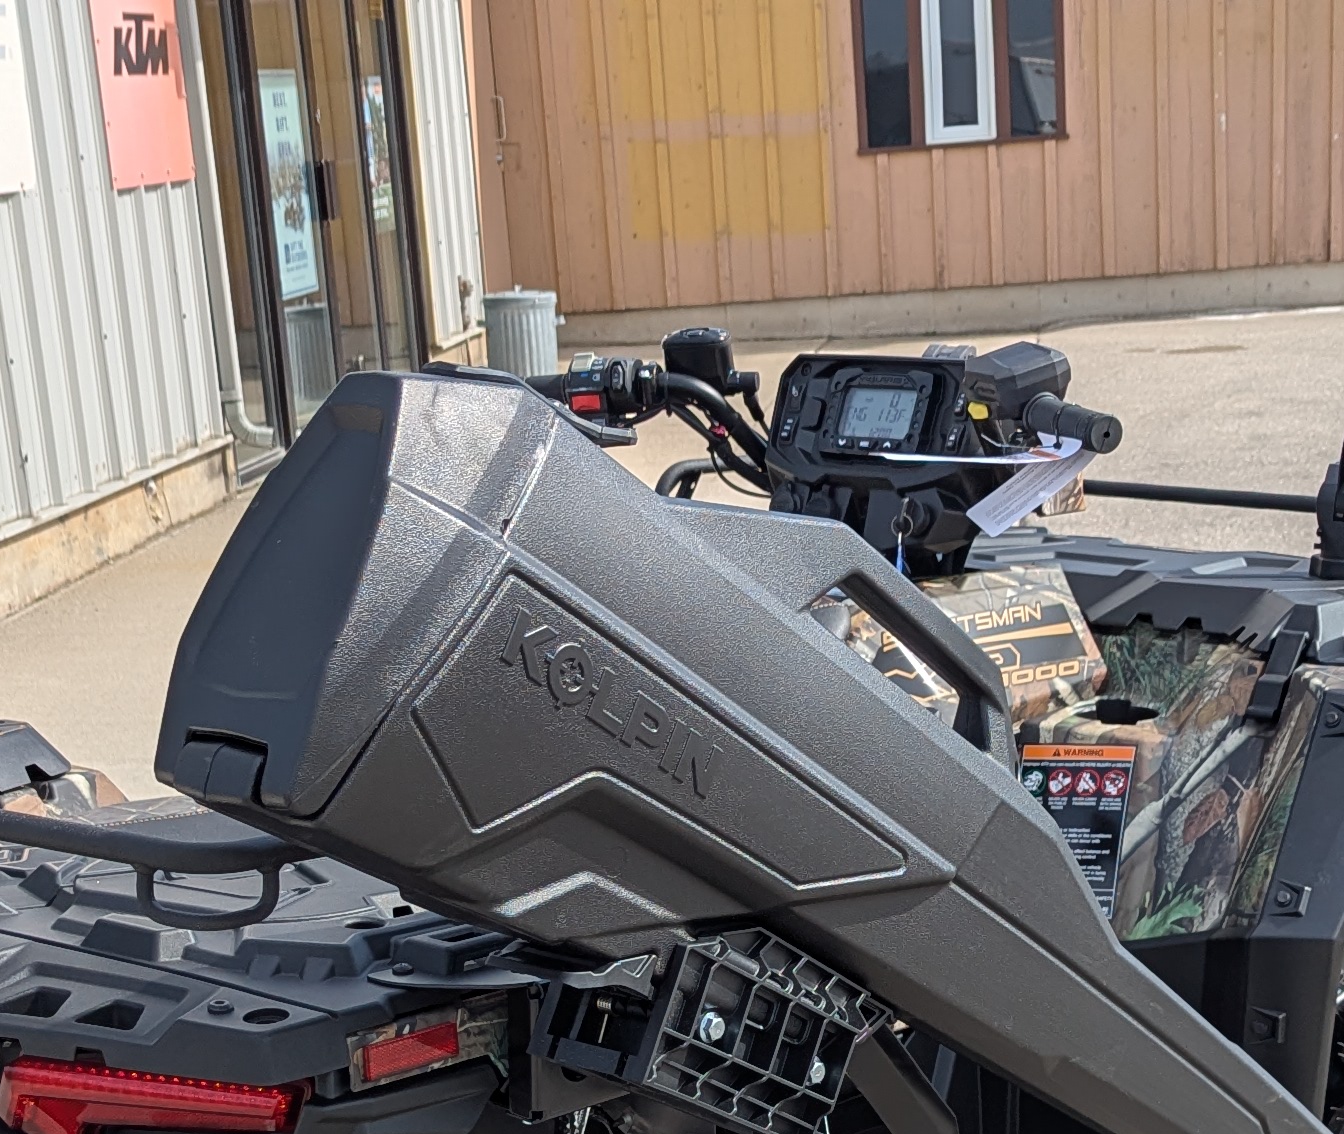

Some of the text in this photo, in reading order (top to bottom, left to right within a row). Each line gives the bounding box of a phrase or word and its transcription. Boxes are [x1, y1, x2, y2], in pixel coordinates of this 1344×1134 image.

[113, 12, 170, 77] KTM
[500, 607, 725, 800] KOLPIN
[1063, 748, 1104, 758] WARNING
